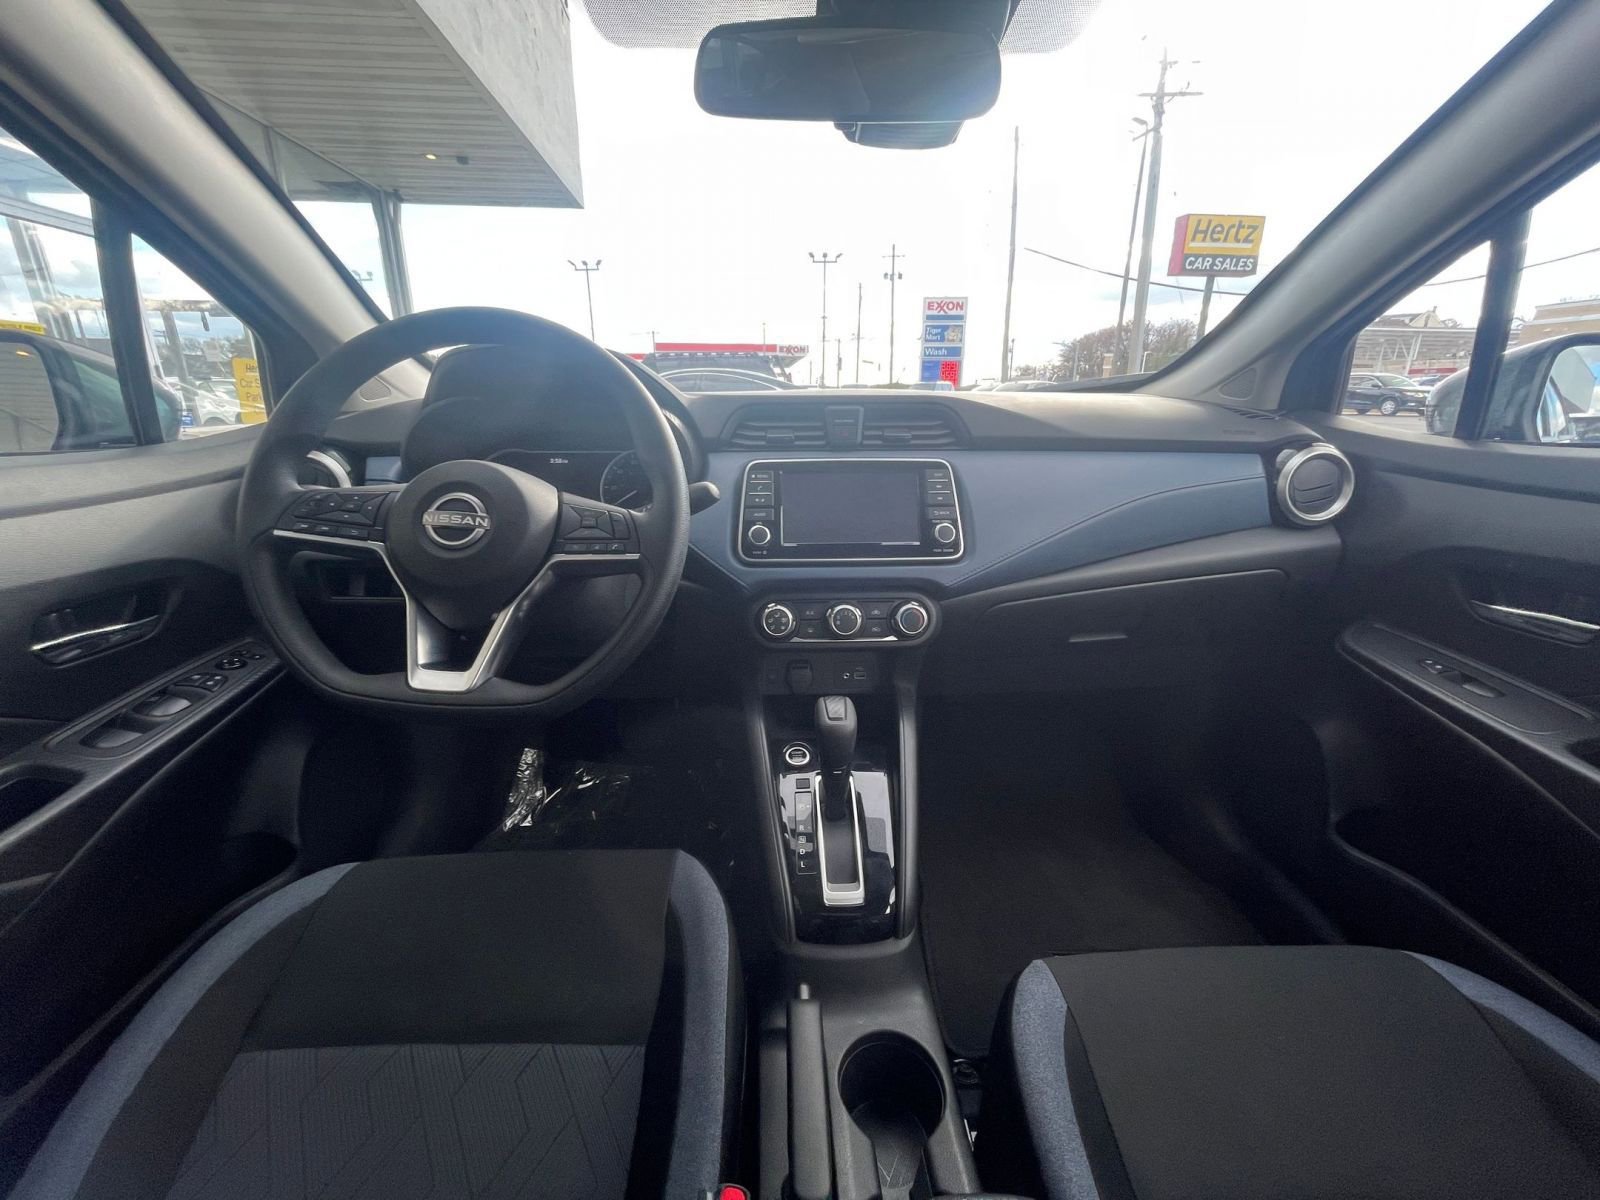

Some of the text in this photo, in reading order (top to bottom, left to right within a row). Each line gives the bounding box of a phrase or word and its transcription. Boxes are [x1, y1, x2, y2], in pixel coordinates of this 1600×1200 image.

[1190, 218, 1259, 244] Hertz
[1185, 257, 1254, 271] CAR SALES
[927, 299, 964, 314] EXXON
[779, 344, 806, 355] EXXON
[925, 347, 948, 356] Wash
[422, 513, 489, 527] NISSAN
